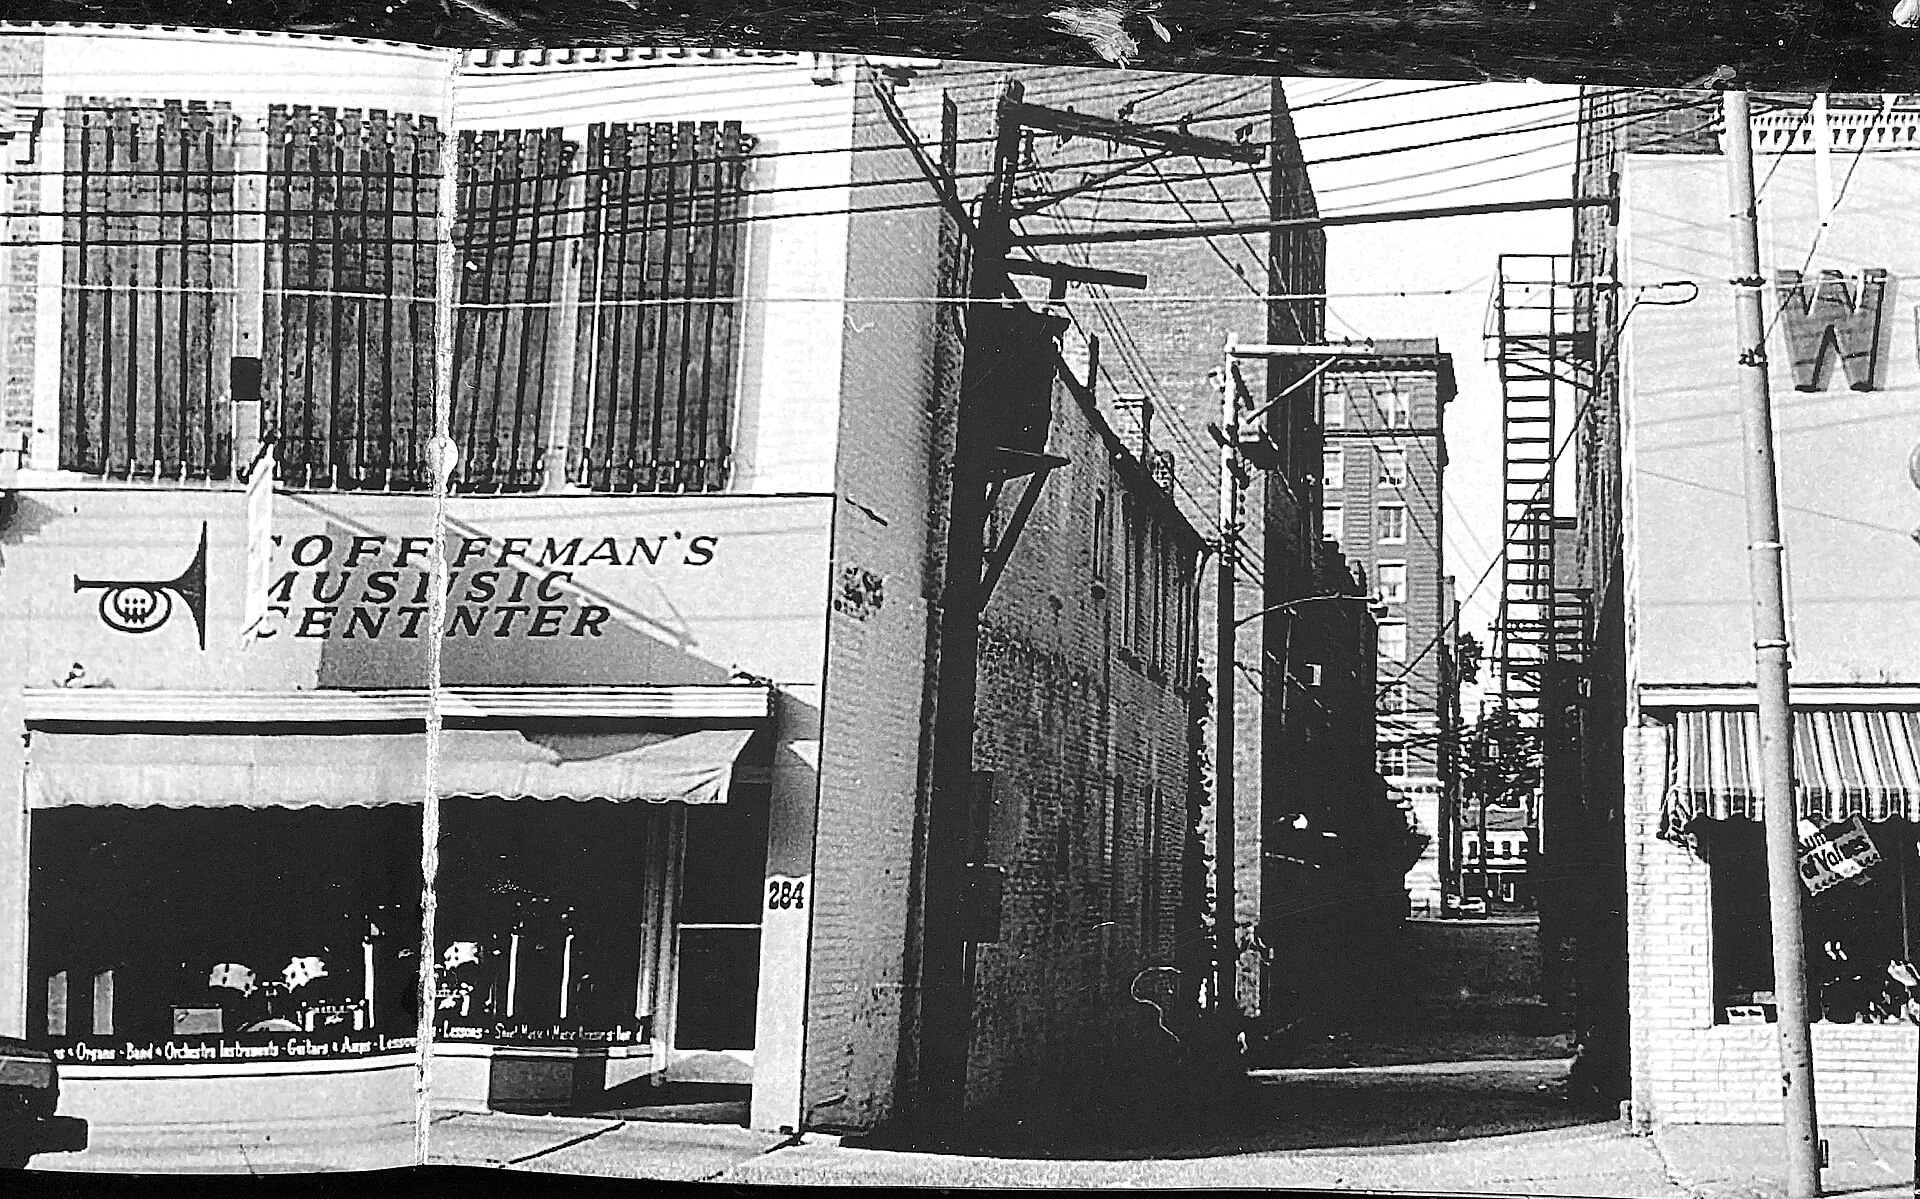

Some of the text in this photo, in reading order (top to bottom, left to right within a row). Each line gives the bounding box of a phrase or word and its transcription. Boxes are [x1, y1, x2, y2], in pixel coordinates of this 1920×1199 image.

[769, 881, 804, 910] 284
[76, 1041, 116, 1062] Organs
[126, 1042, 154, 1061] Band
[287, 1037, 329, 1056] Guitars
